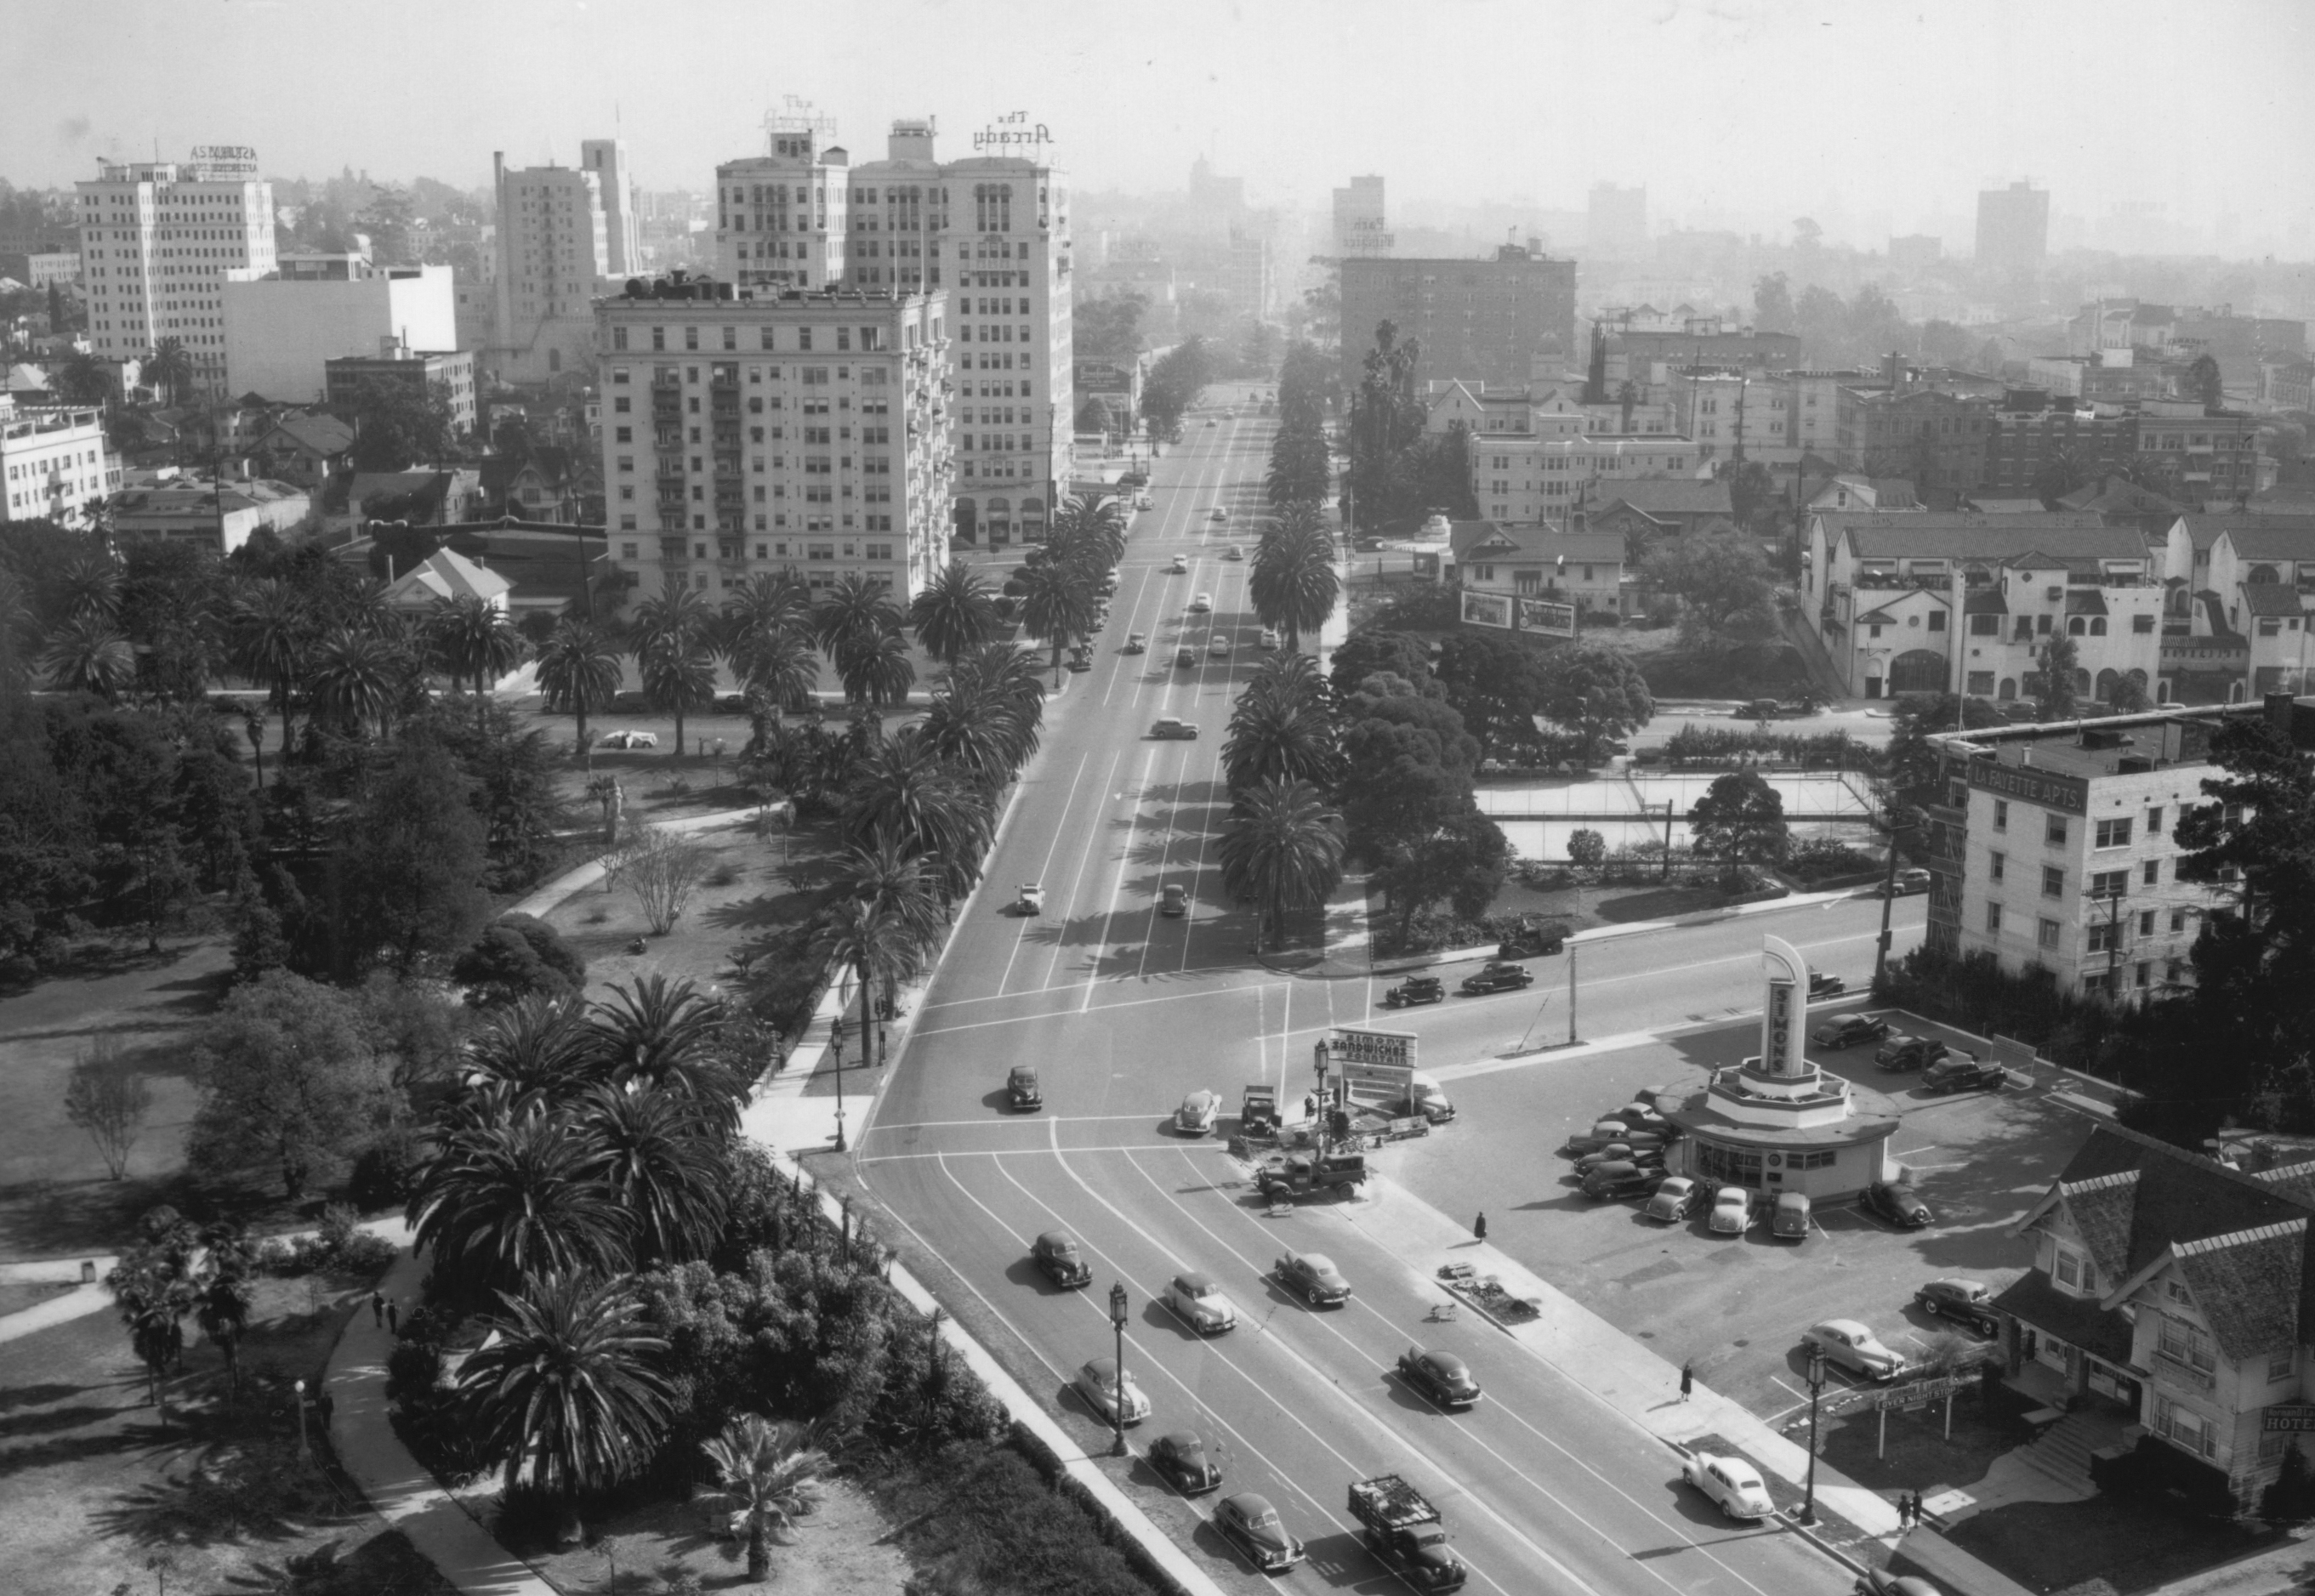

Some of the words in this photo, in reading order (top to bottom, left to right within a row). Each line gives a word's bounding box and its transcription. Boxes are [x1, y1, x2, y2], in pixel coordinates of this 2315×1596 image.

[1989, 769, 2038, 798] FAYETTE
[2042, 783, 2081, 809] APTS.
[1773, 989, 1788, 1071] SIMONS
[1332, 1041, 1407, 1056] SANDWICHES
[1346, 1052, 1407, 1065] FOUNTAIN
[2101, 1364, 2130, 1384] HOTEL
[1882, 1397, 1905, 1408] OVER
[1907, 1391, 1932, 1403] NIGHT
[1934, 1386, 1956, 1397] STOP
[2267, 1417, 2315, 1429] HOTE
